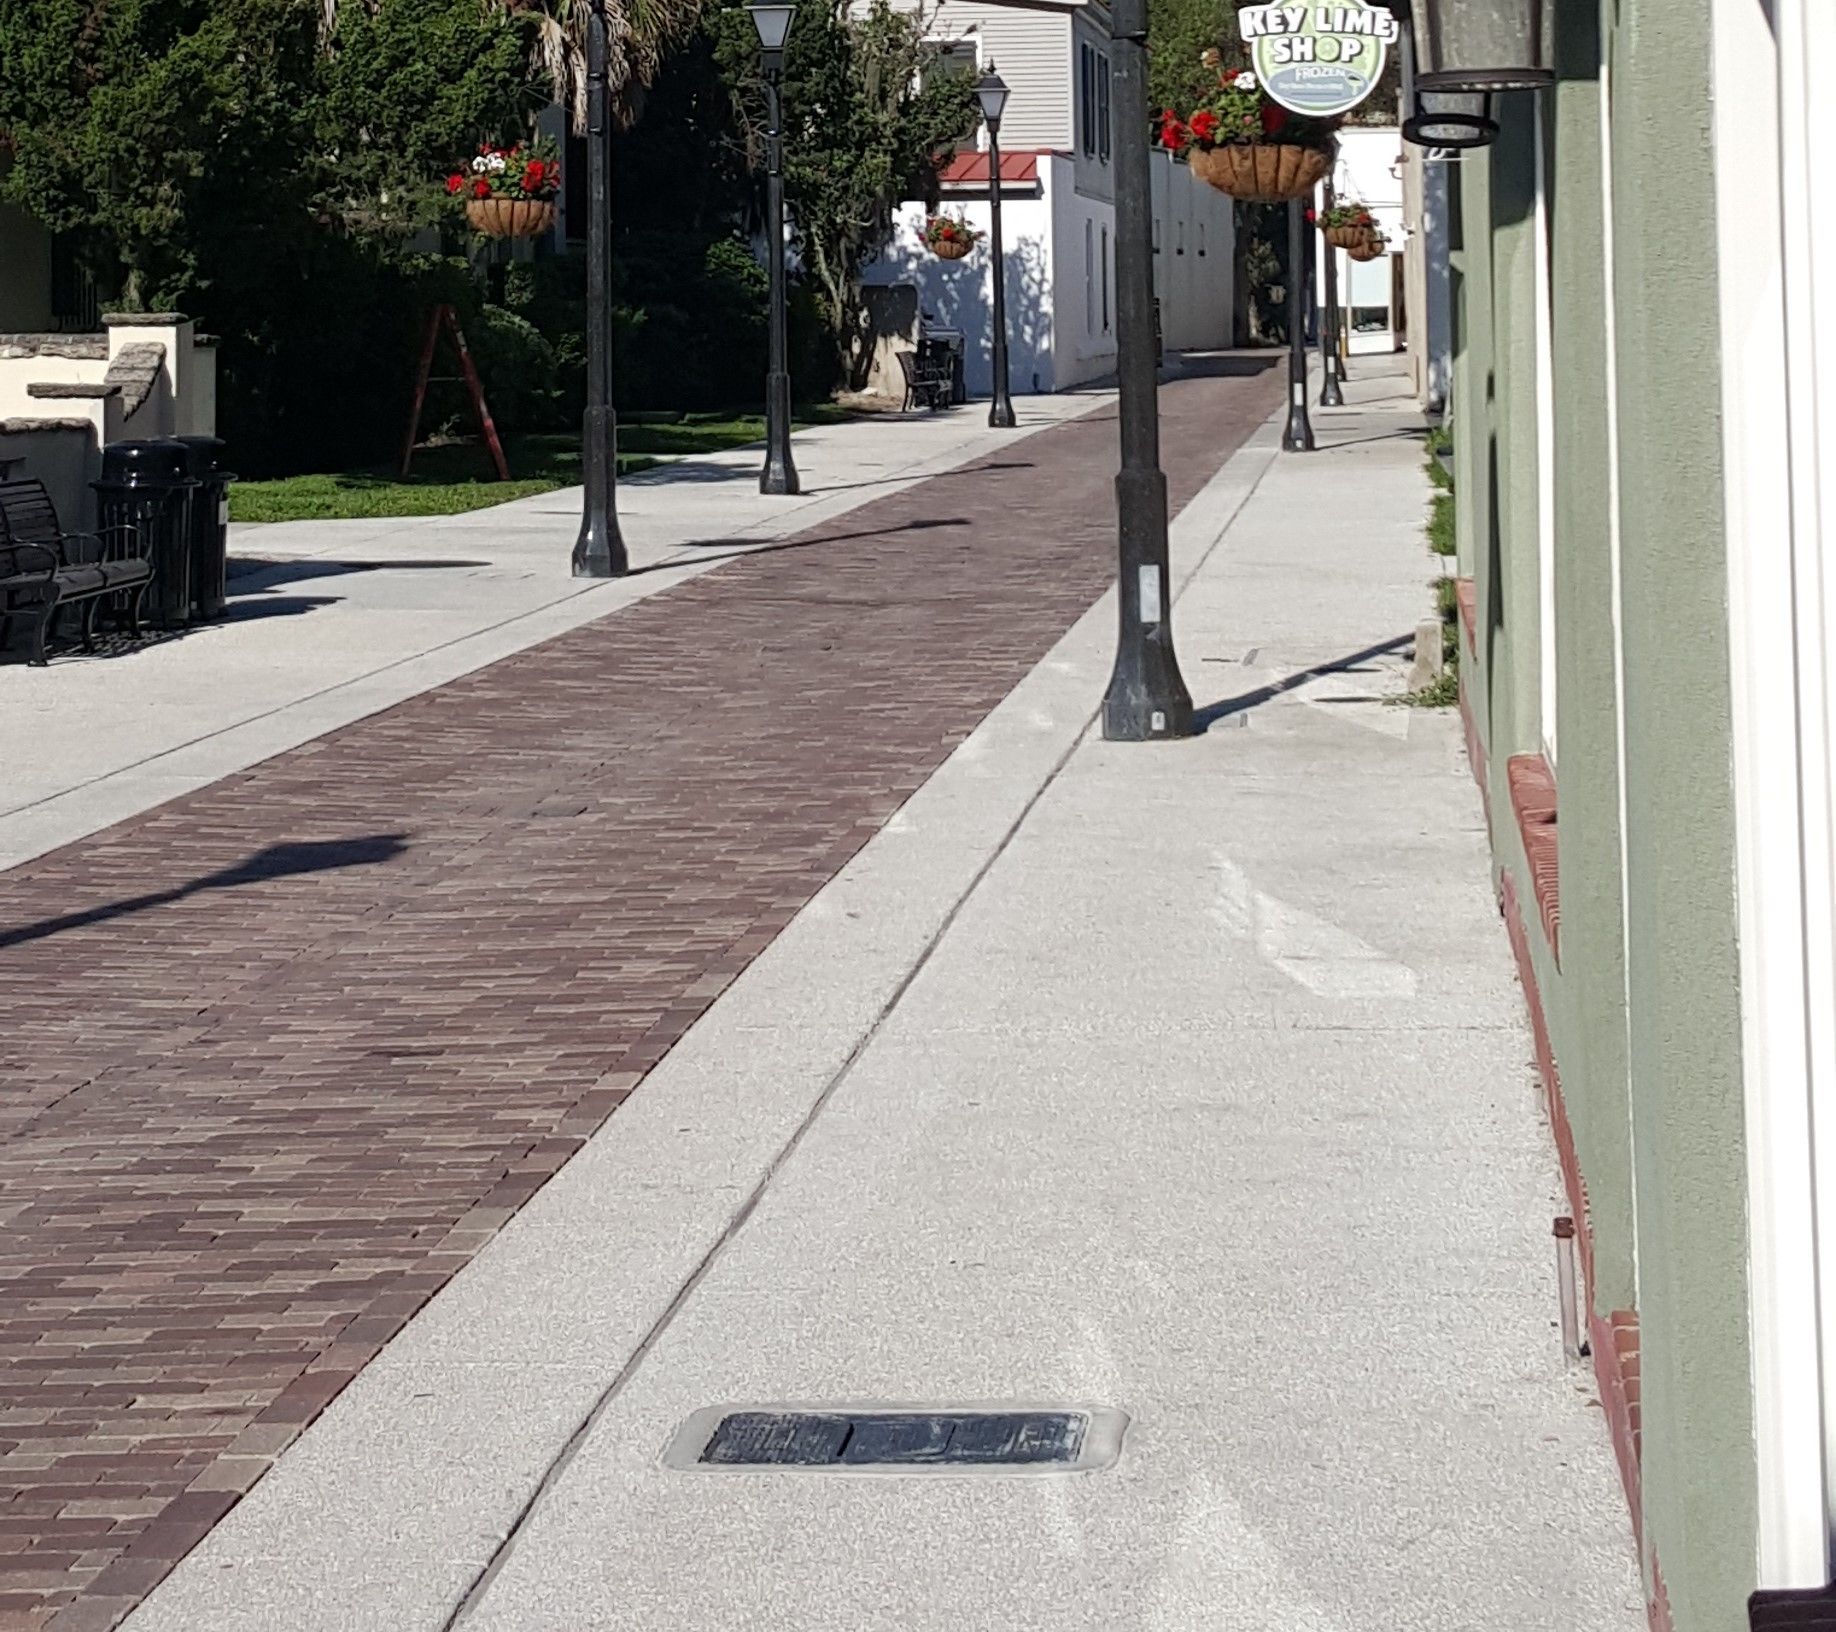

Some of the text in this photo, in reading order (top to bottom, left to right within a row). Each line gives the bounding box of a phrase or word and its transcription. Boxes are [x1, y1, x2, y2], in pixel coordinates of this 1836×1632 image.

[1243, 7, 1394, 37] KEY LIME
[1273, 36, 1363, 64] SHOP
[1295, 67, 1345, 82] FROZEN
